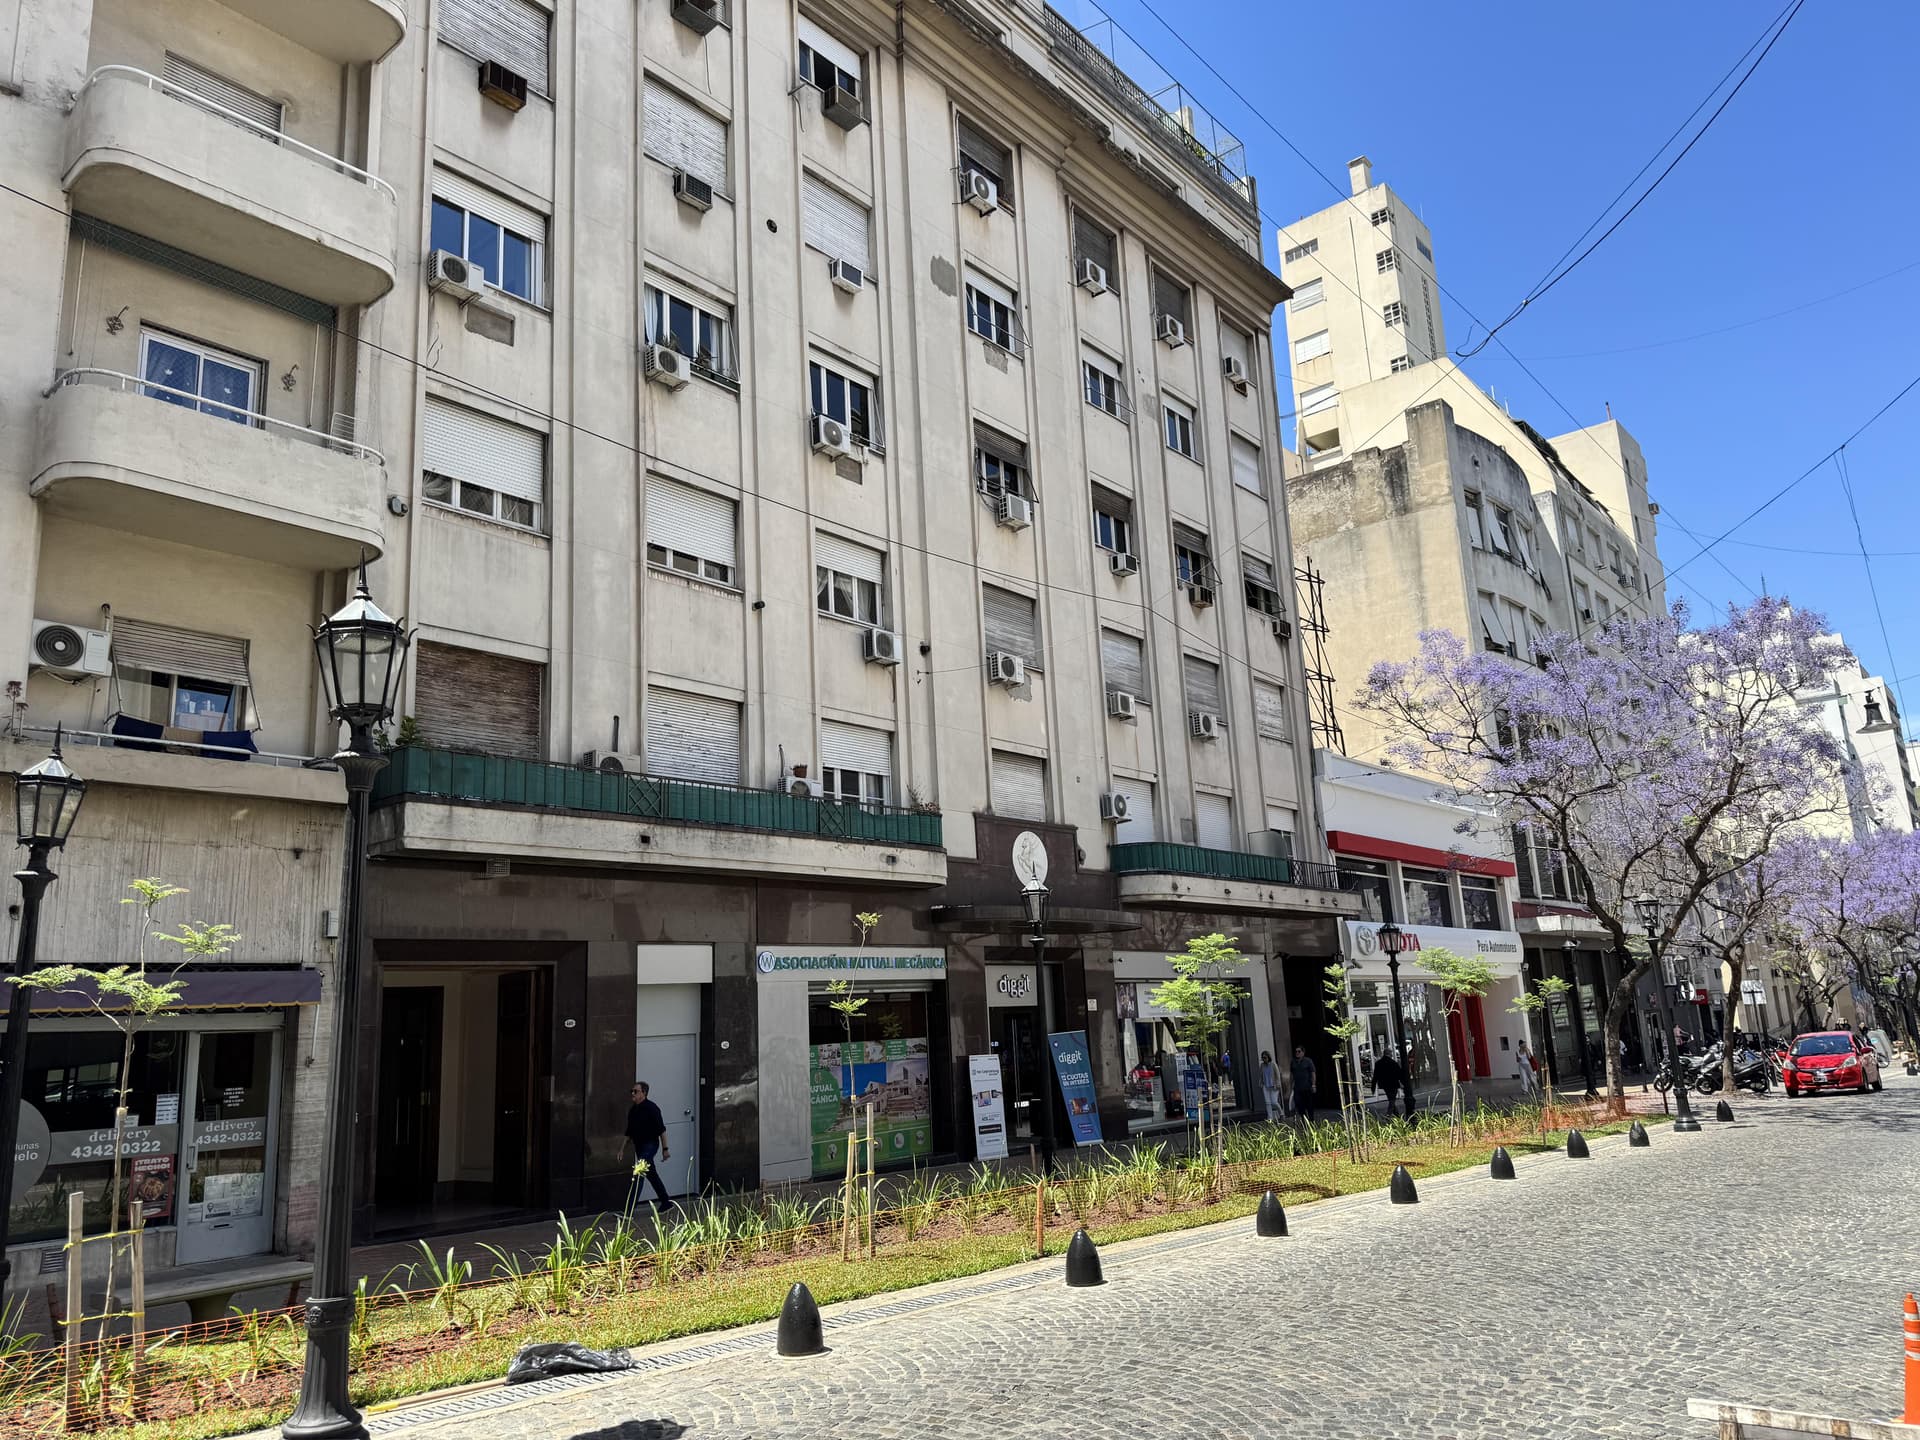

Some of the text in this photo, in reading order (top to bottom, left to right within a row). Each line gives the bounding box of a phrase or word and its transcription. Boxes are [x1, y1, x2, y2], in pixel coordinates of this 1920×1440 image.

[1377, 933, 1421, 952] TOTA
[774, 954, 947, 970] ASOCIACIÓN MUTUAL MECÁNICA
[999, 974, 1031, 998] diggit
[1058, 1050, 1083, 1065] diggit
[810, 1083, 834, 1094] UTUAL
[811, 1094, 839, 1105] CÁNICA
[205, 1120, 257, 1133] delivery
[196, 1131, 262, 1145] 4342-0322
[15, 1142, 40, 1151] lunas
[14, 1150, 38, 1161] elo
